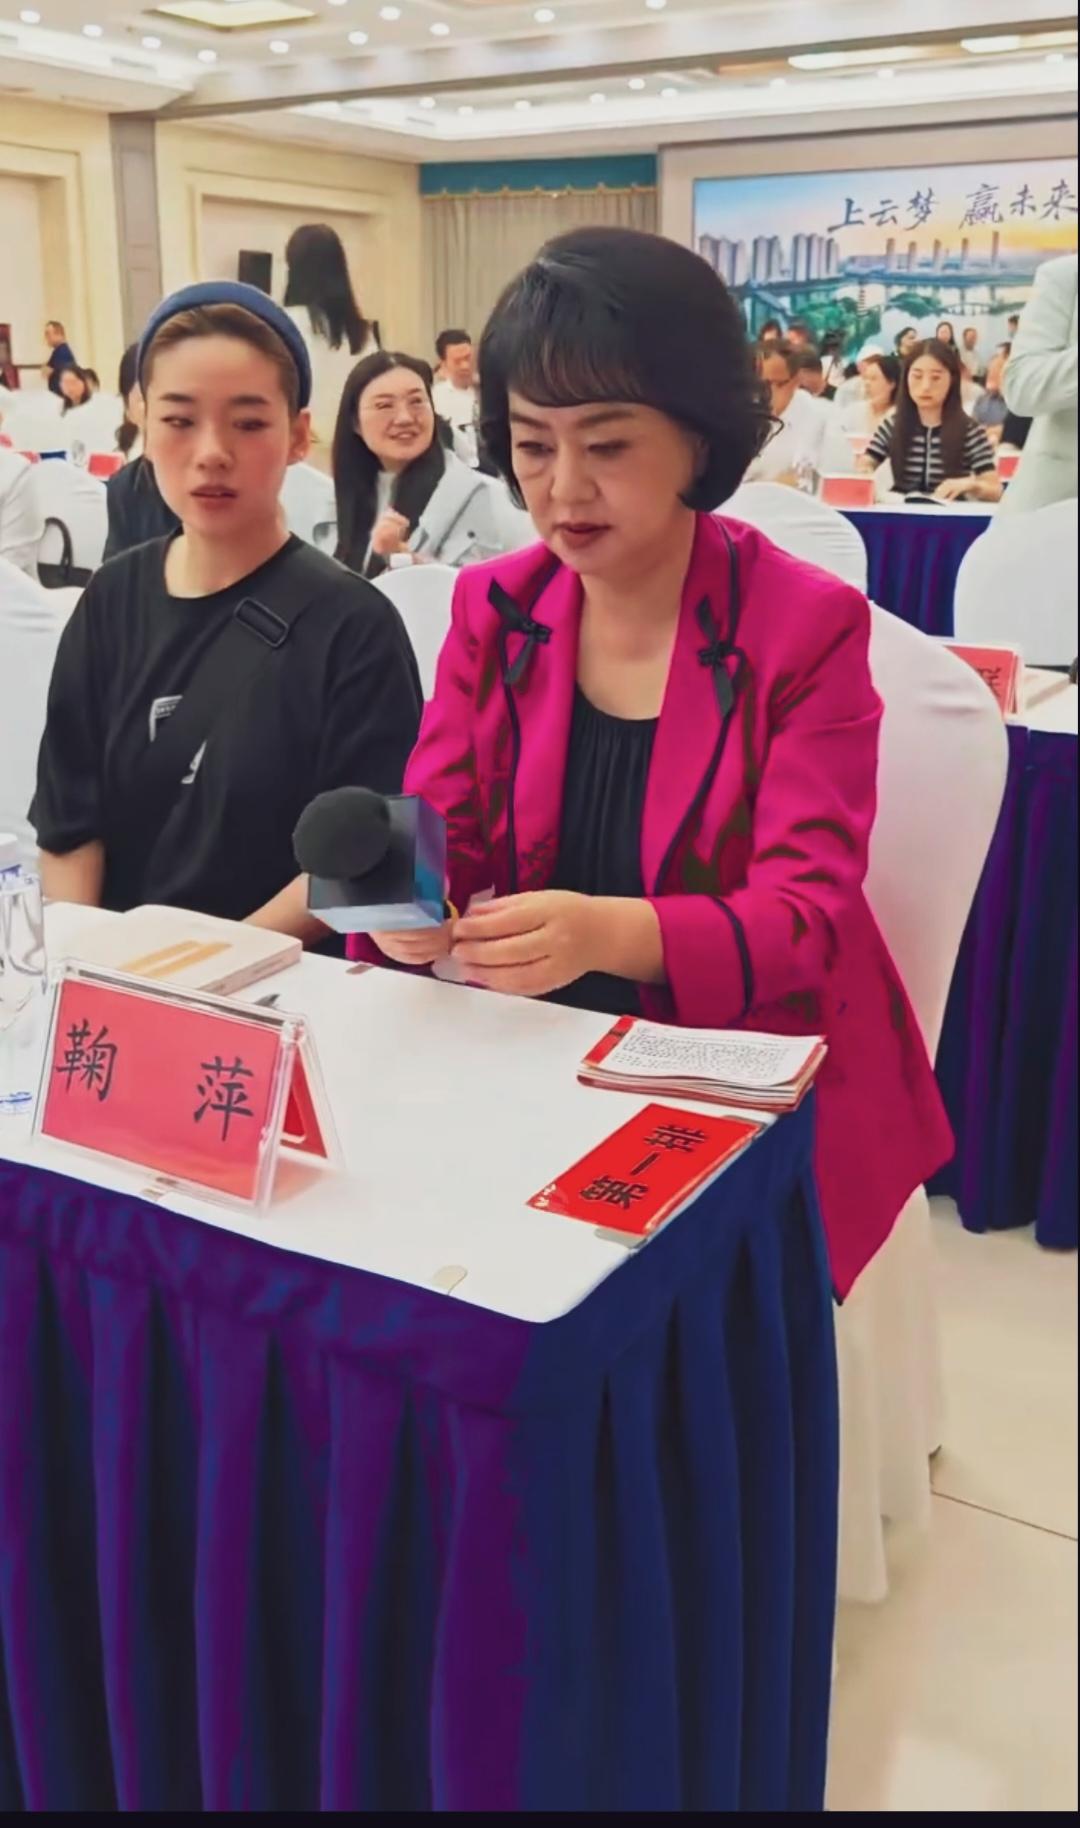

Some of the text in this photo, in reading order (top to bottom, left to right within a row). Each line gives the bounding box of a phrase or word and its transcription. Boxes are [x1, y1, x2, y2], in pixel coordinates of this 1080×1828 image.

[827, 179, 1077, 233] 上云梦 赢未来
[56, 1018, 255, 1142] 鞠 萍
[579, 1123, 709, 1210] 第一排
